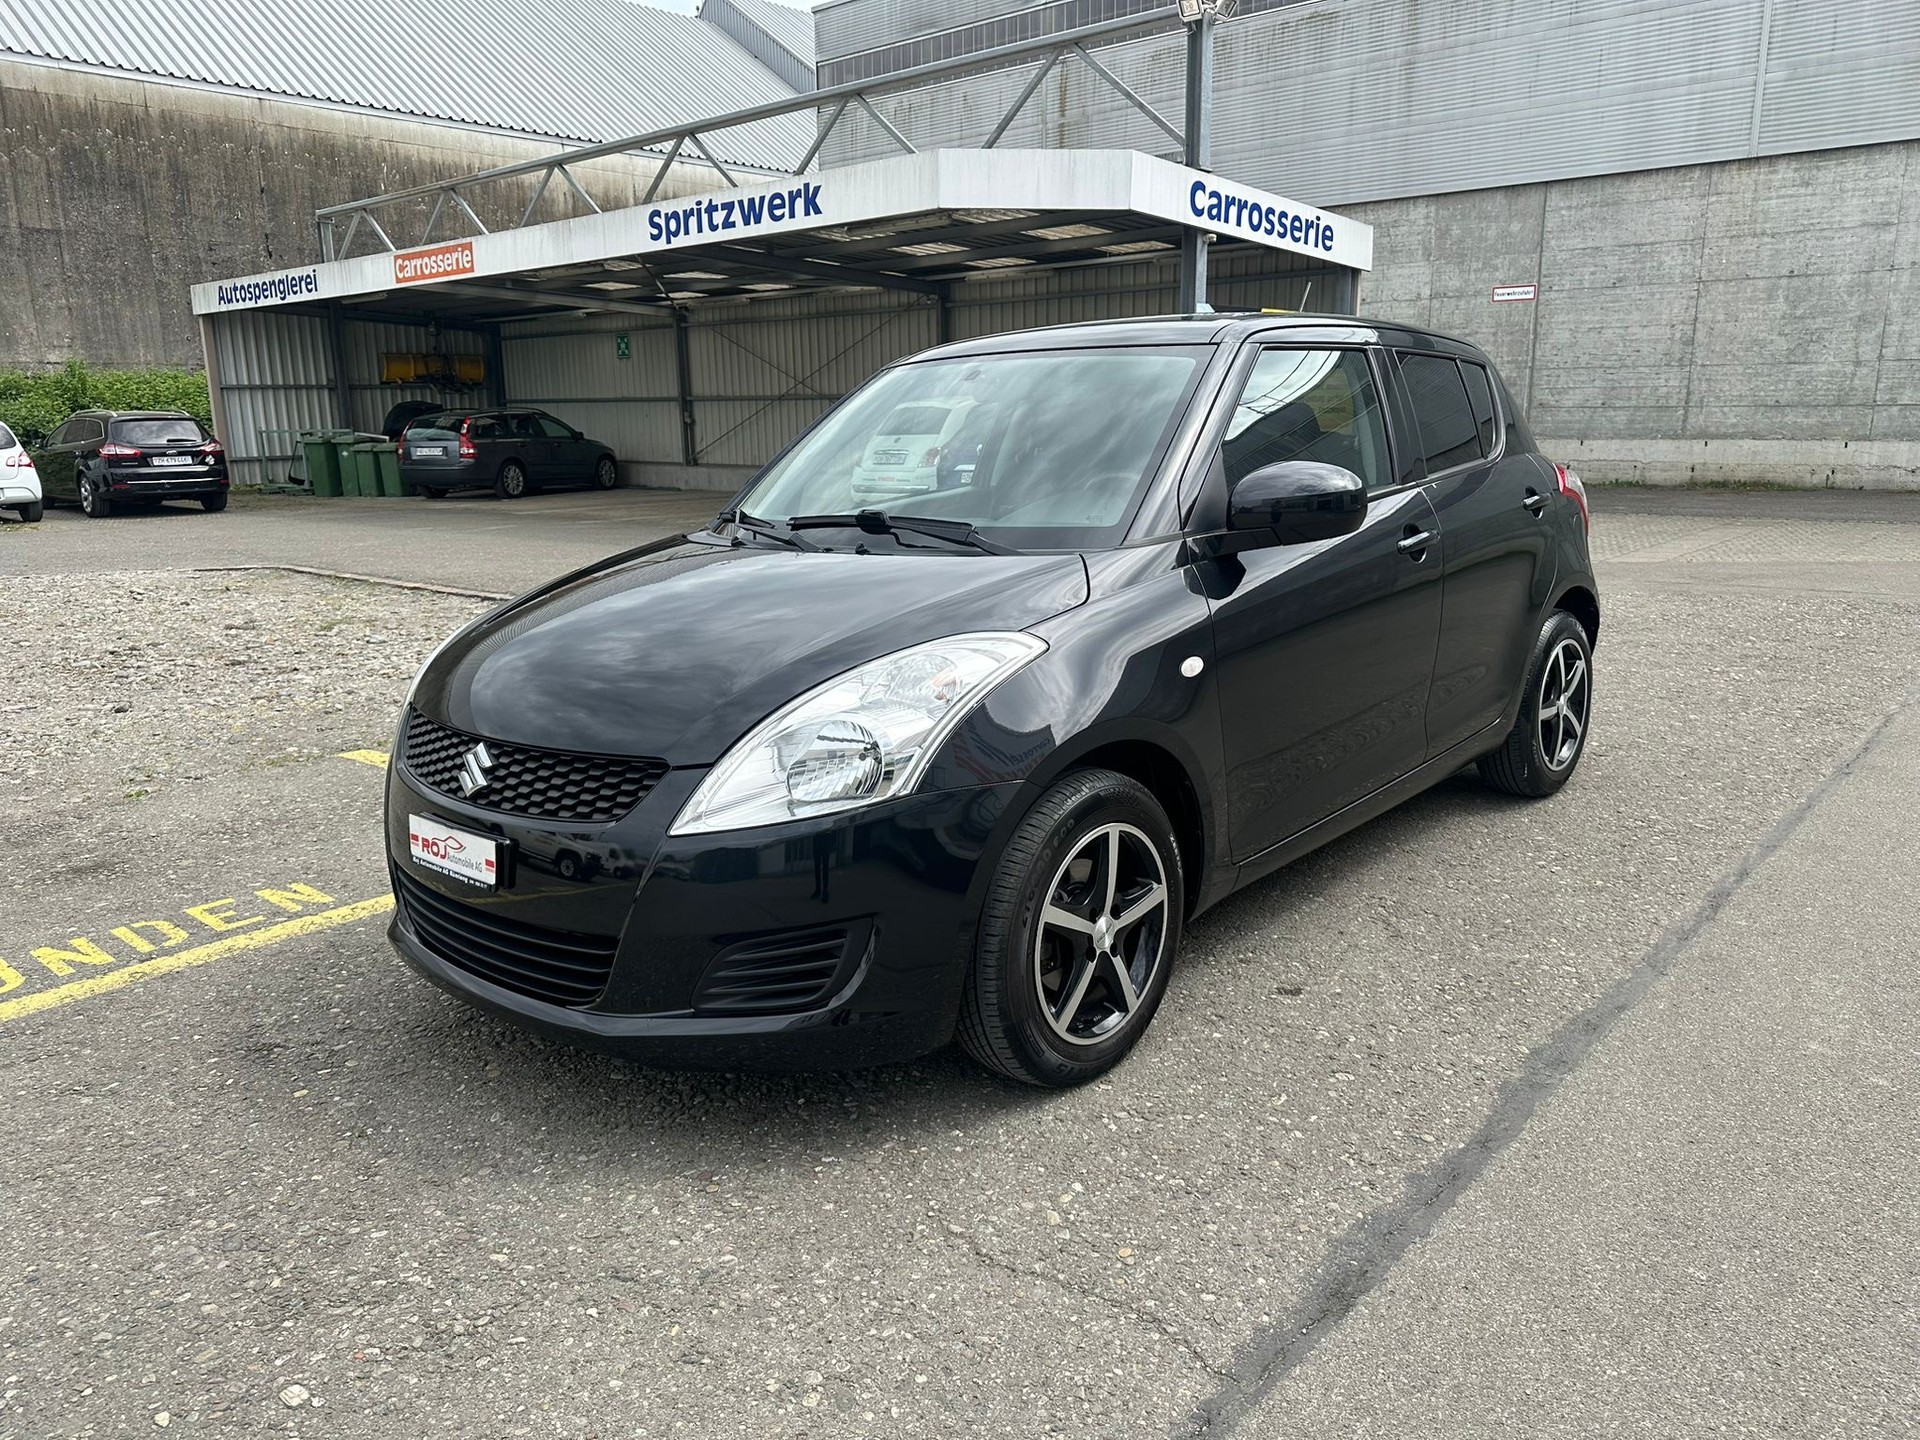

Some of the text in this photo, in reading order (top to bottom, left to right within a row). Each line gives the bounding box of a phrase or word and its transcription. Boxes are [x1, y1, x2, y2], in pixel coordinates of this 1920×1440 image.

[648, 182, 823, 245] Spritzwerk
[1190, 180, 1334, 251] Carrosserie
[395, 246, 472, 279] Carrosserie
[217, 269, 319, 306] Autospenglerei
[447, 851, 483, 873] Automobile AG
